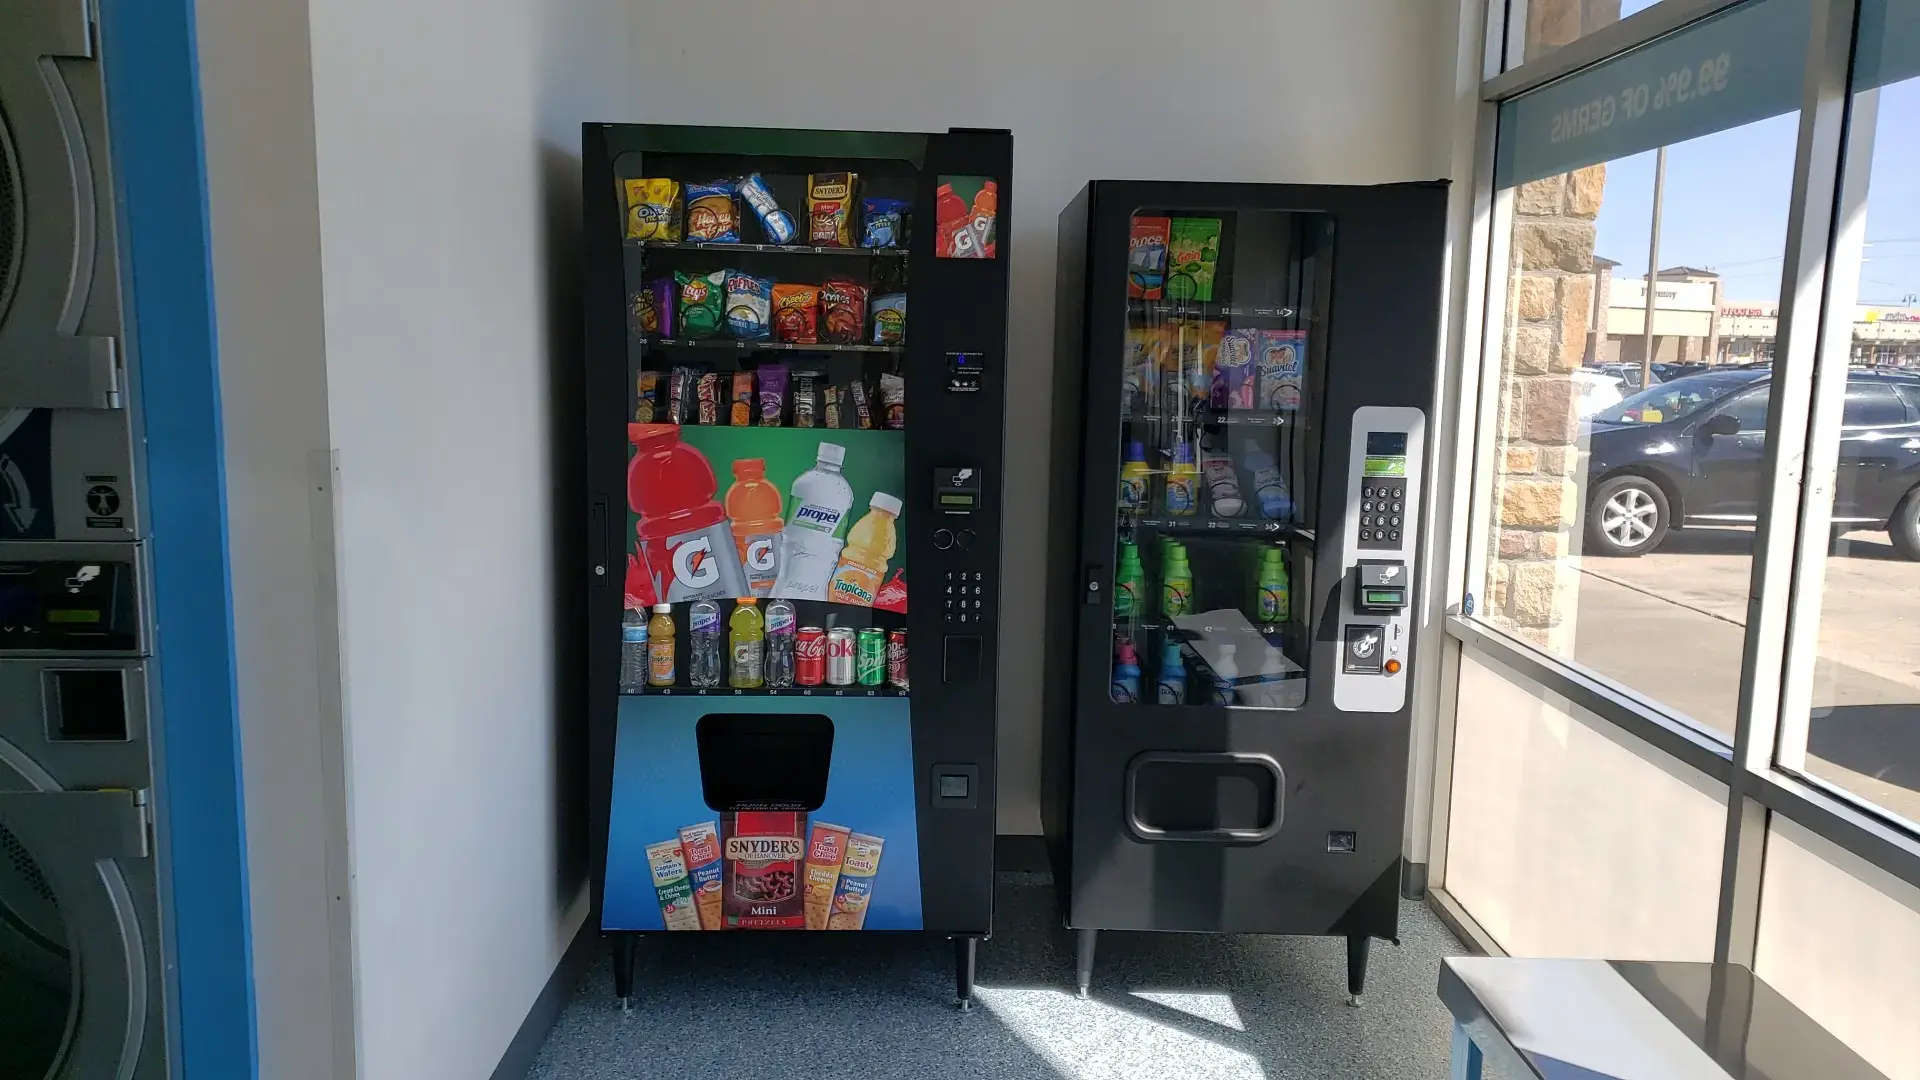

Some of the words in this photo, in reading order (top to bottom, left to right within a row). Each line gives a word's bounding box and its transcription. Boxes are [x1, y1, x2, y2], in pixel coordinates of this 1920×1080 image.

[814, 185, 845, 196] SNYDER'S
[974, 216, 988, 231] G
[954, 229, 973, 250] G
[1260, 361, 1298, 377] Suavitel
[1381, 488, 1387, 496] 2
[1395, 488, 1401, 496] 3
[1365, 502, 1371, 511] 4
[1394, 502, 1400, 511] 6
[796, 507, 841, 524] propel
[1364, 517, 1370, 525] 7
[1393, 517, 1399, 525] 9
[1378, 531, 1383, 539] 0
[746, 538, 776, 571] G
[672, 535, 721, 589] G
[961, 572, 967, 580] 2
[975, 572, 981, 580] 3
[833, 578, 873, 603] Tropicana
[946, 586, 952, 594] 4
[975, 586, 981, 594] 6
[947, 600, 952, 608] 7
[961, 600, 966, 608] 8
[975, 600, 981, 608] 9
[961, 614, 966, 622] 0
[729, 839, 801, 855] SNYDER'S
[814, 841, 839, 855] Toast
[812, 850, 837, 862] Chee
[844, 856, 874, 871] Toasty
[656, 867, 683, 879] Wafers
[697, 867, 720, 876] Peanut
[810, 868, 836, 879] Cheddar
[698, 874, 719, 882] Butter
[809, 874, 831, 884] Cheese
[846, 878, 868, 888] Peanut
[658, 887, 674, 896] Cream
[844, 885, 865, 894] Butter
[751, 906, 777, 915] Mini
